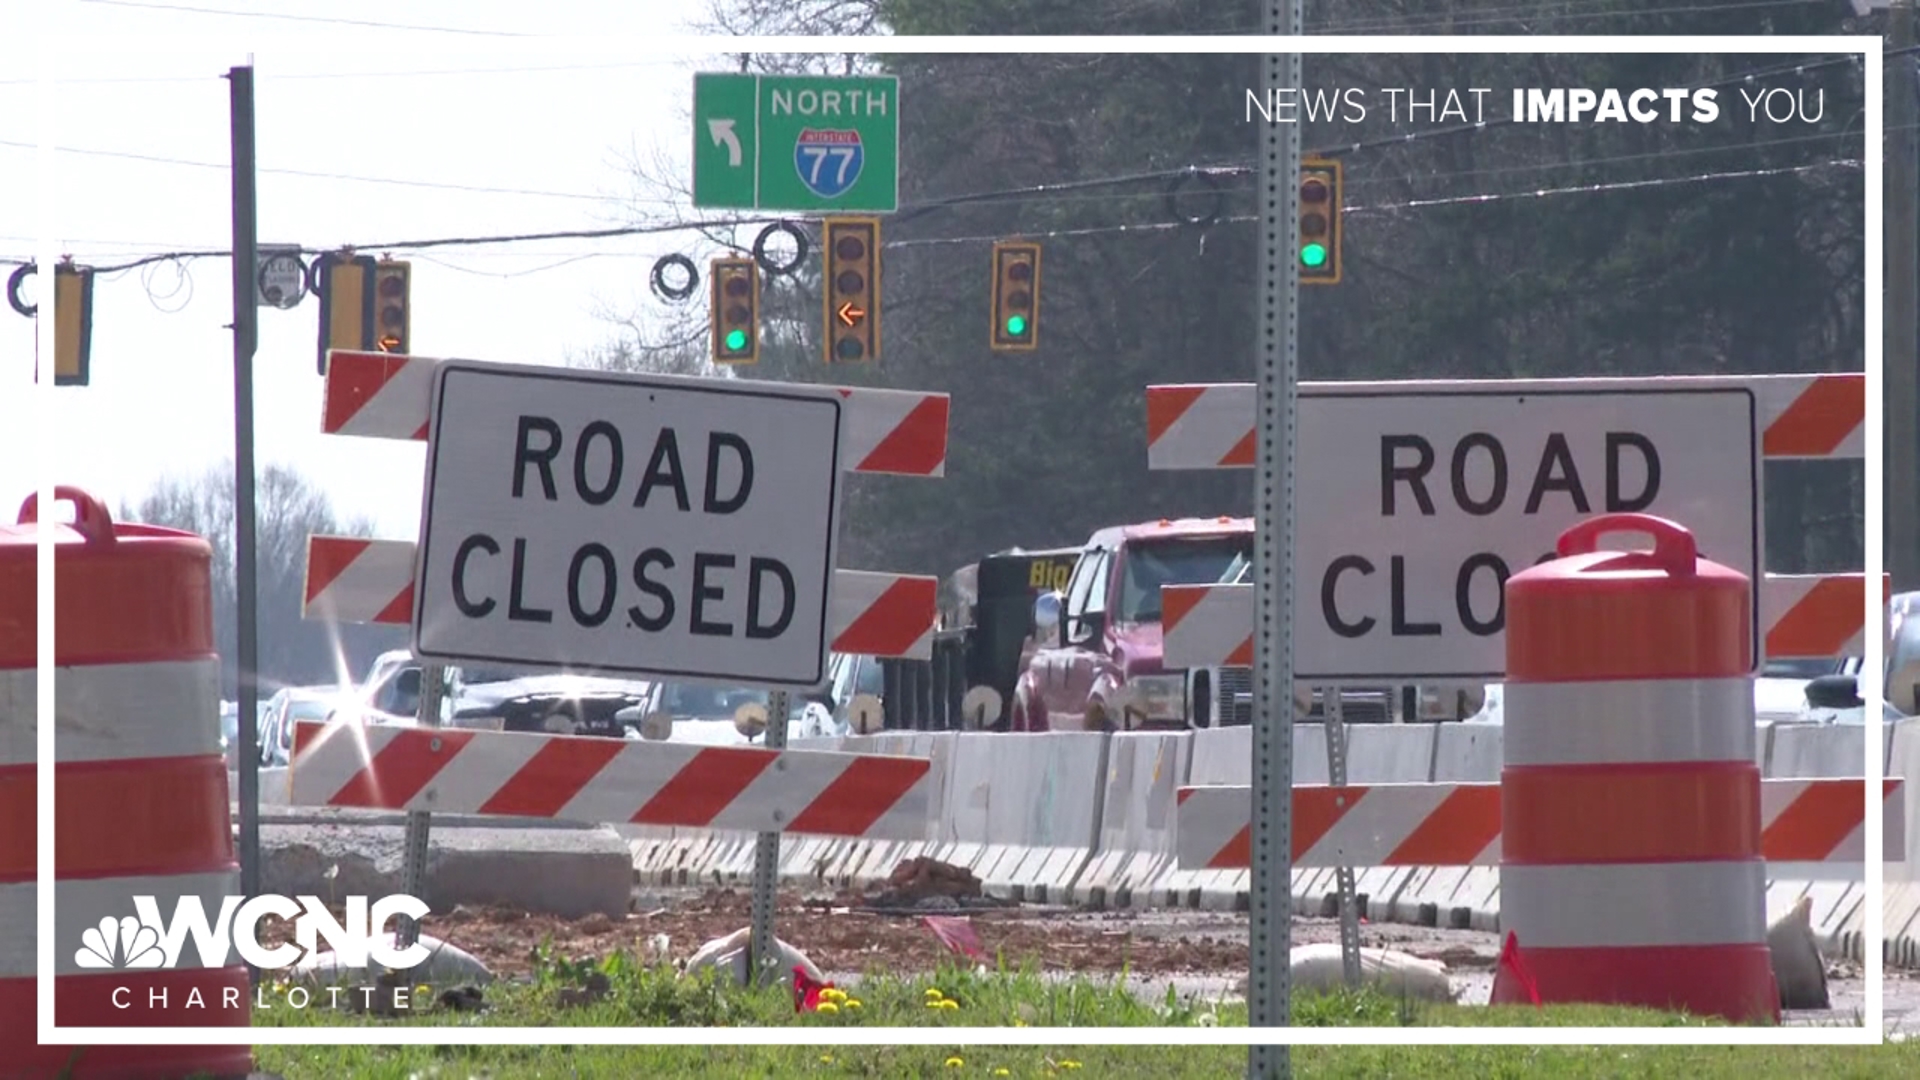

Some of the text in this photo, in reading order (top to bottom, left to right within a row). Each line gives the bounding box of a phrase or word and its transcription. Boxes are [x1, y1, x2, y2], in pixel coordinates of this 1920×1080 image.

[771, 90, 887, 115] NORTH
[803, 147, 855, 184] 77
[510, 414, 756, 516] ROAD
[1379, 430, 1663, 518] ROAD
[450, 531, 798, 641] CLOSED
[1030, 559, 1070, 593] Big
[1320, 550, 1557, 640] CLO
